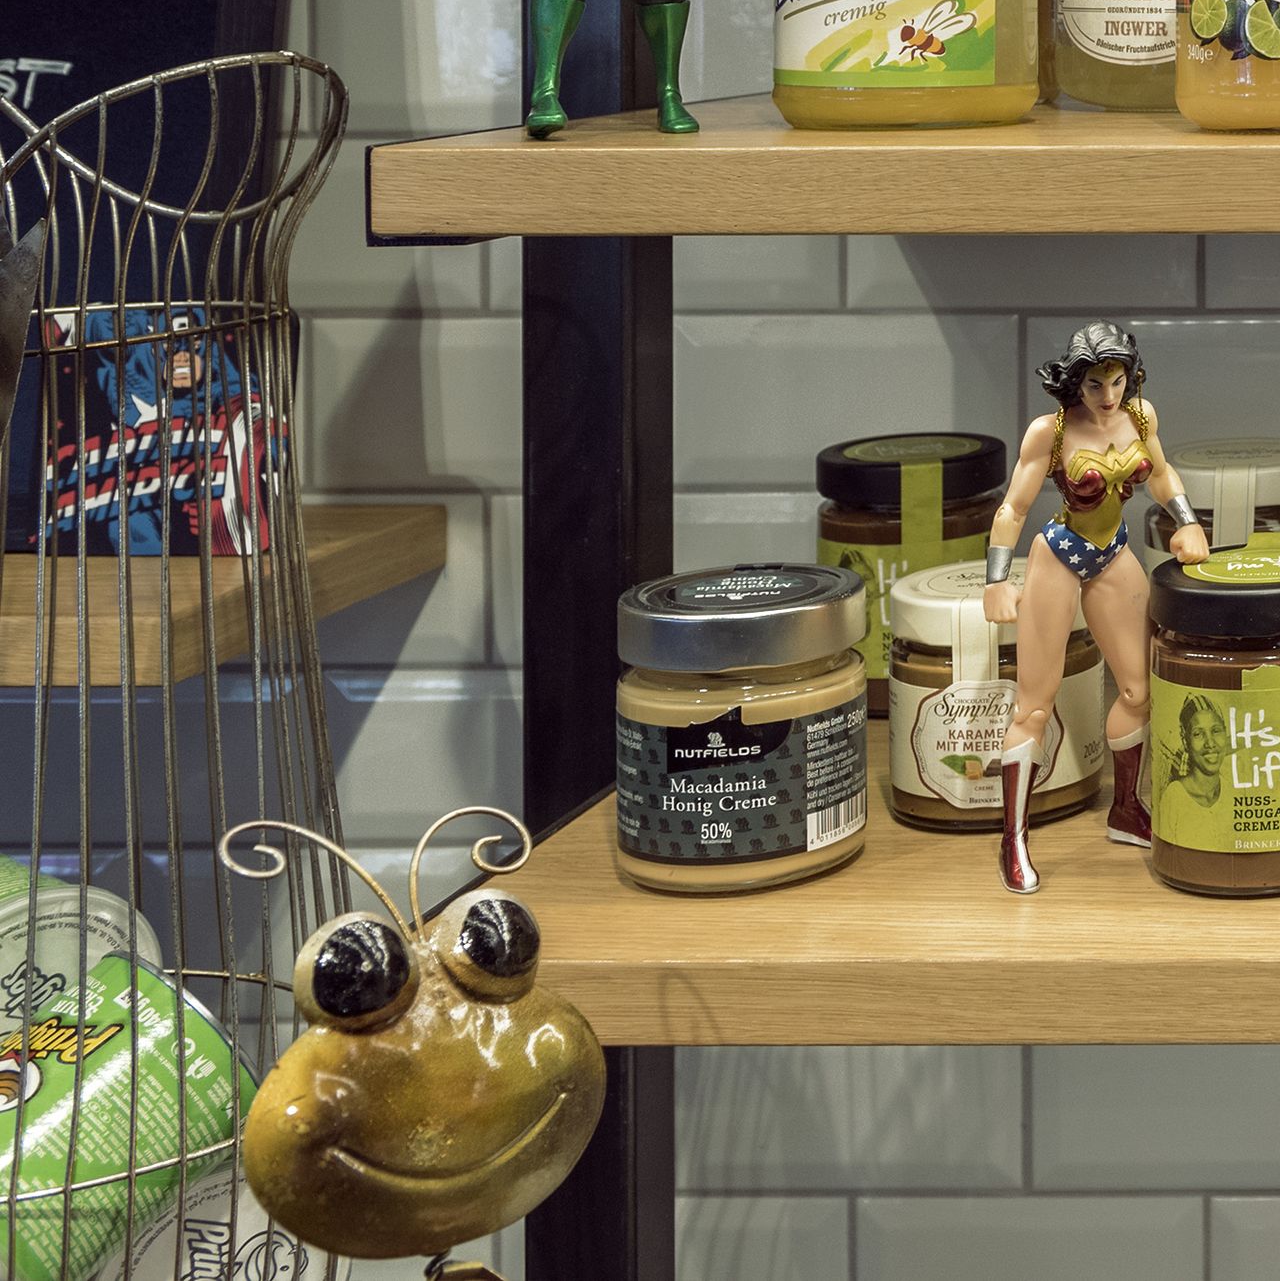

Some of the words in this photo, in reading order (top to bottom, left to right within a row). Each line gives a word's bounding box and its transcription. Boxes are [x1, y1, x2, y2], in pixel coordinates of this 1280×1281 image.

[1103, 20, 1169, 37] INGWER
[933, 692, 1014, 725] Sympho
[806, 721, 831, 733] Nutfields
[948, 727, 1009, 741] KARAME
[674, 744, 762, 759] NUTFIELDS
[936, 739, 960, 753] MIT
[961, 739, 1005, 753] MEERS
[669, 777, 767, 795] Macadamia
[973, 785, 995, 793] CREME
[661, 795, 714, 817] Honig
[718, 794, 778, 812] Creme
[1233, 795, 1277, 809] NUSS-
[700, 822, 733, 840] 50%
[1233, 819, 1280, 833] CREME
